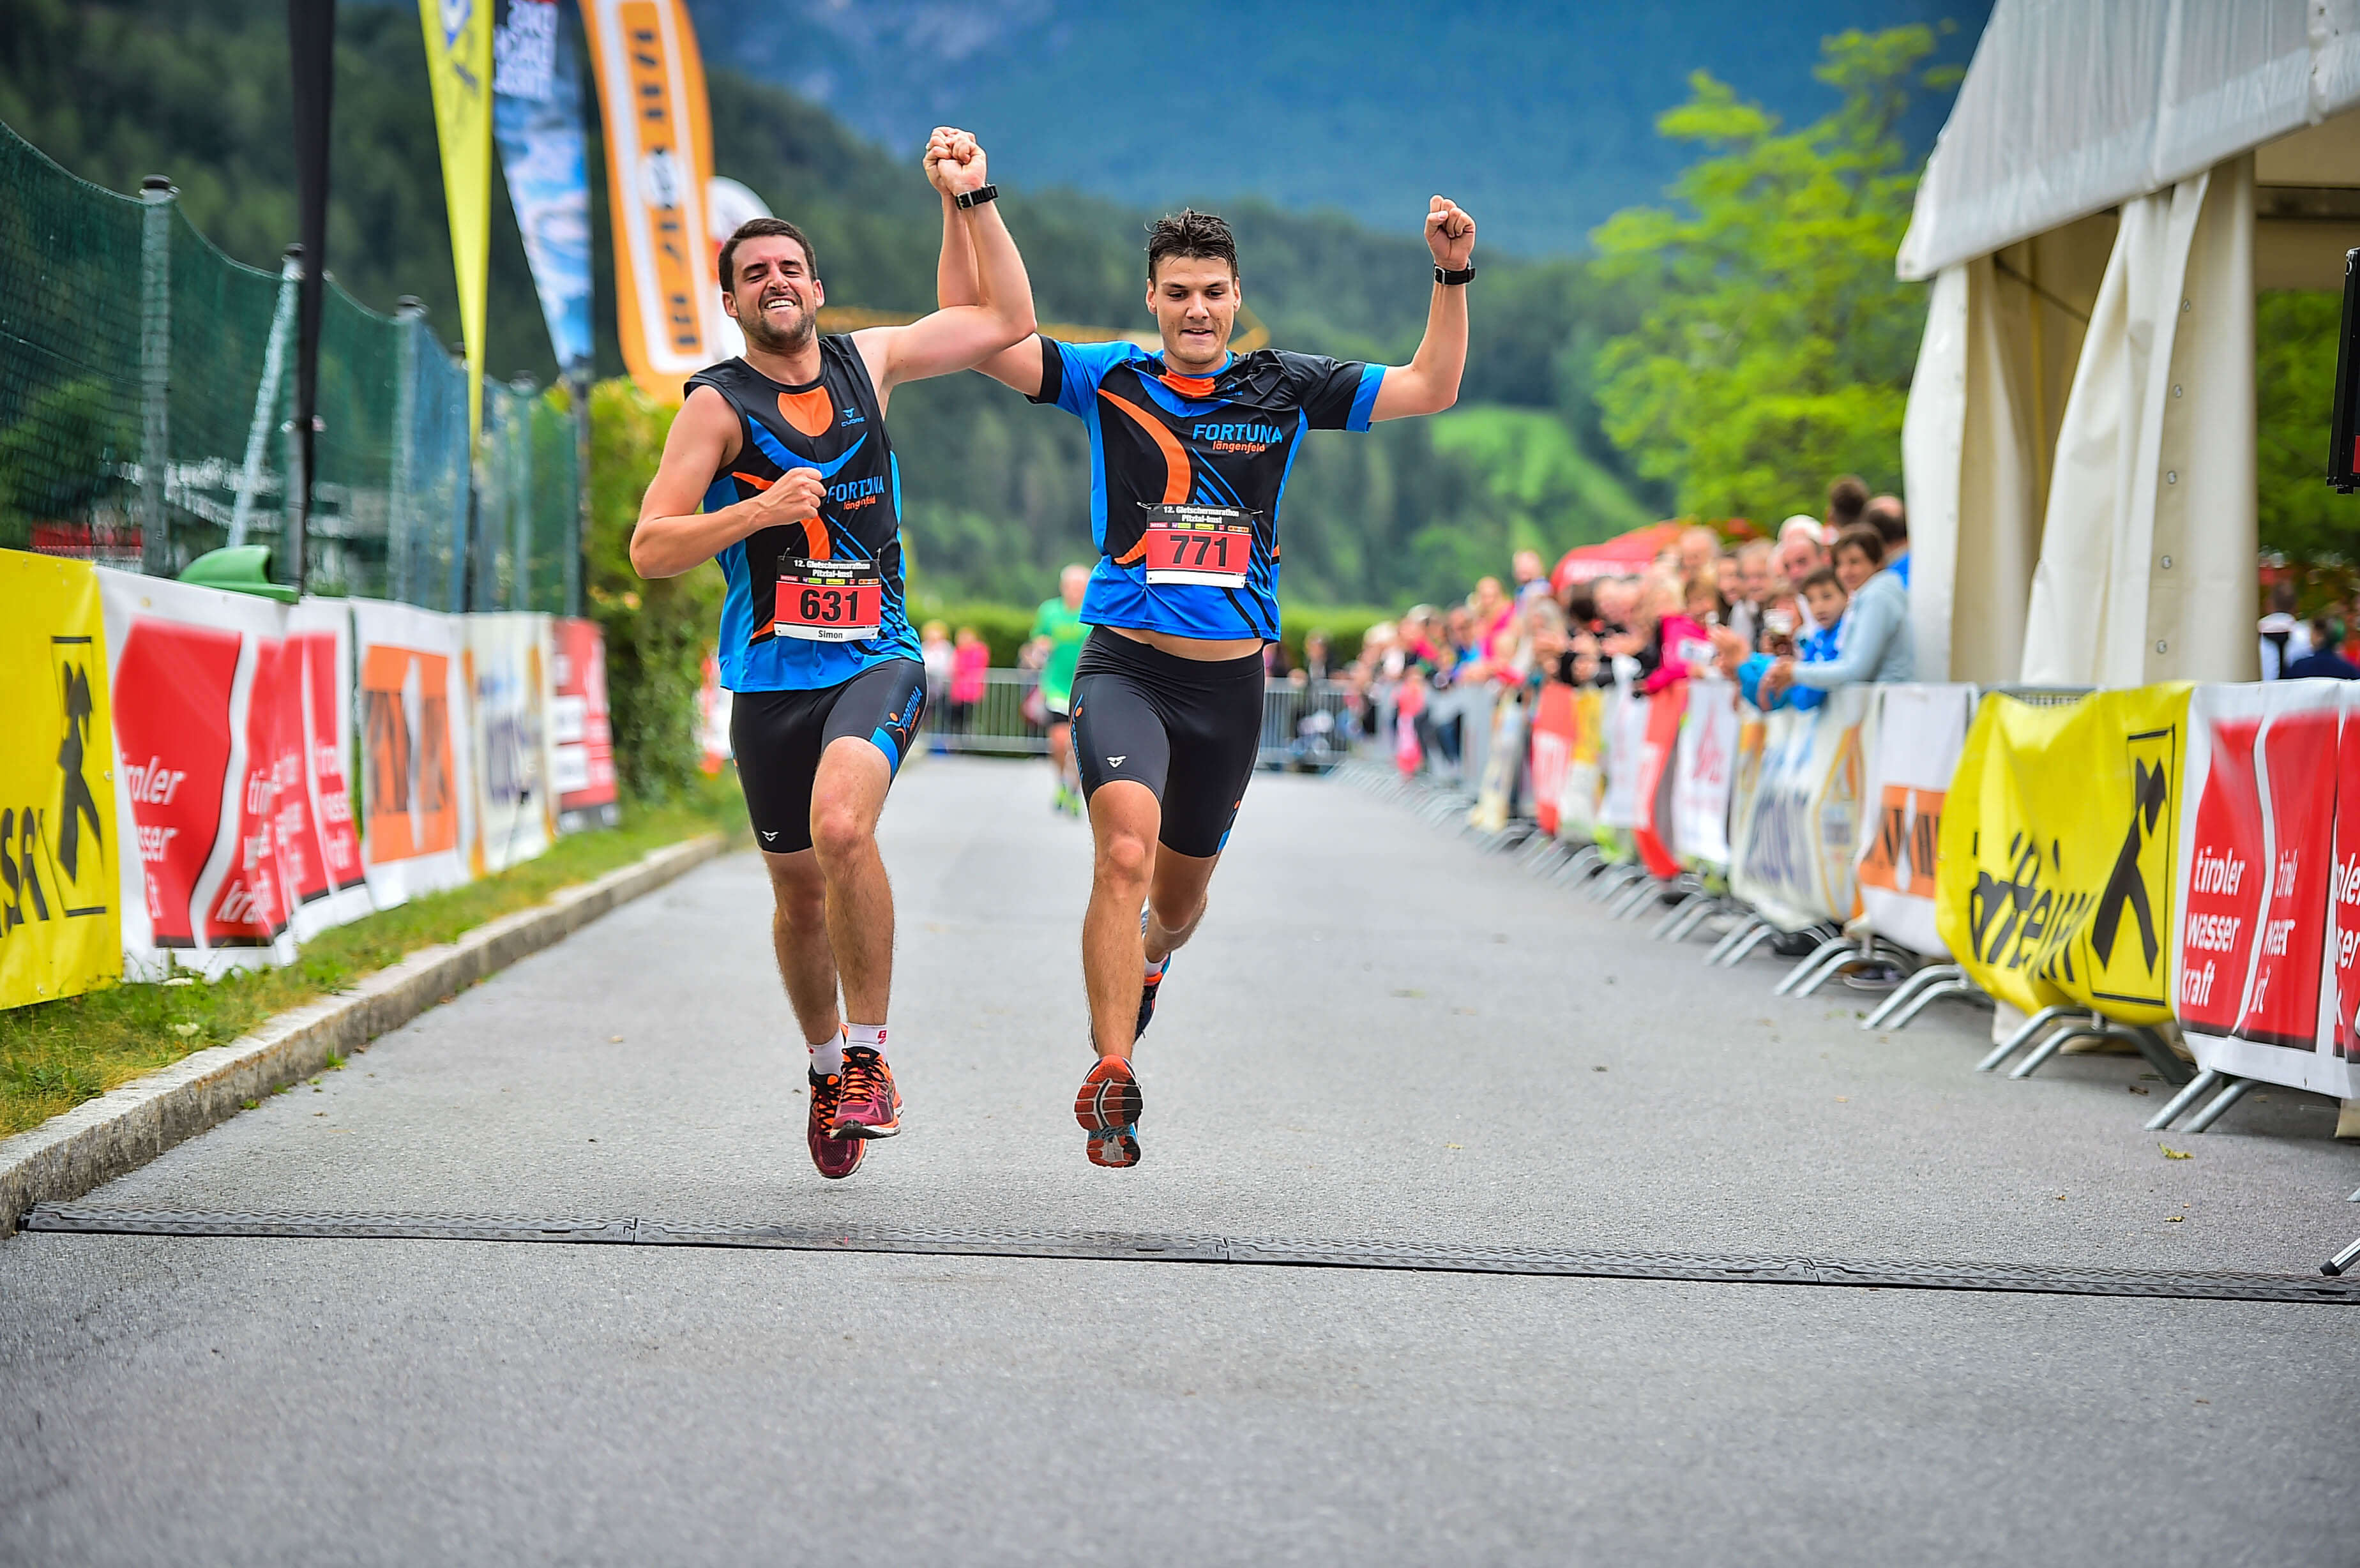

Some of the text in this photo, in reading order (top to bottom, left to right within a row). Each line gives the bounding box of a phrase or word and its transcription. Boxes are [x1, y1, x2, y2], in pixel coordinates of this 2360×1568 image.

[1192, 423, 1283, 443] FORTUNA
[1213, 441, 1266, 454] längenfeld
[1163, 506, 1175, 514] 12.
[794, 559, 806, 568] 12.
[1170, 535, 1227, 567] 771
[800, 589, 858, 621] 631
[818, 630, 843, 639] Simon
[124, 753, 186, 806] roler
[2194, 845, 2246, 896] tiroler
[2186, 911, 2241, 953] wasser
[2181, 957, 2216, 1007] kraft
